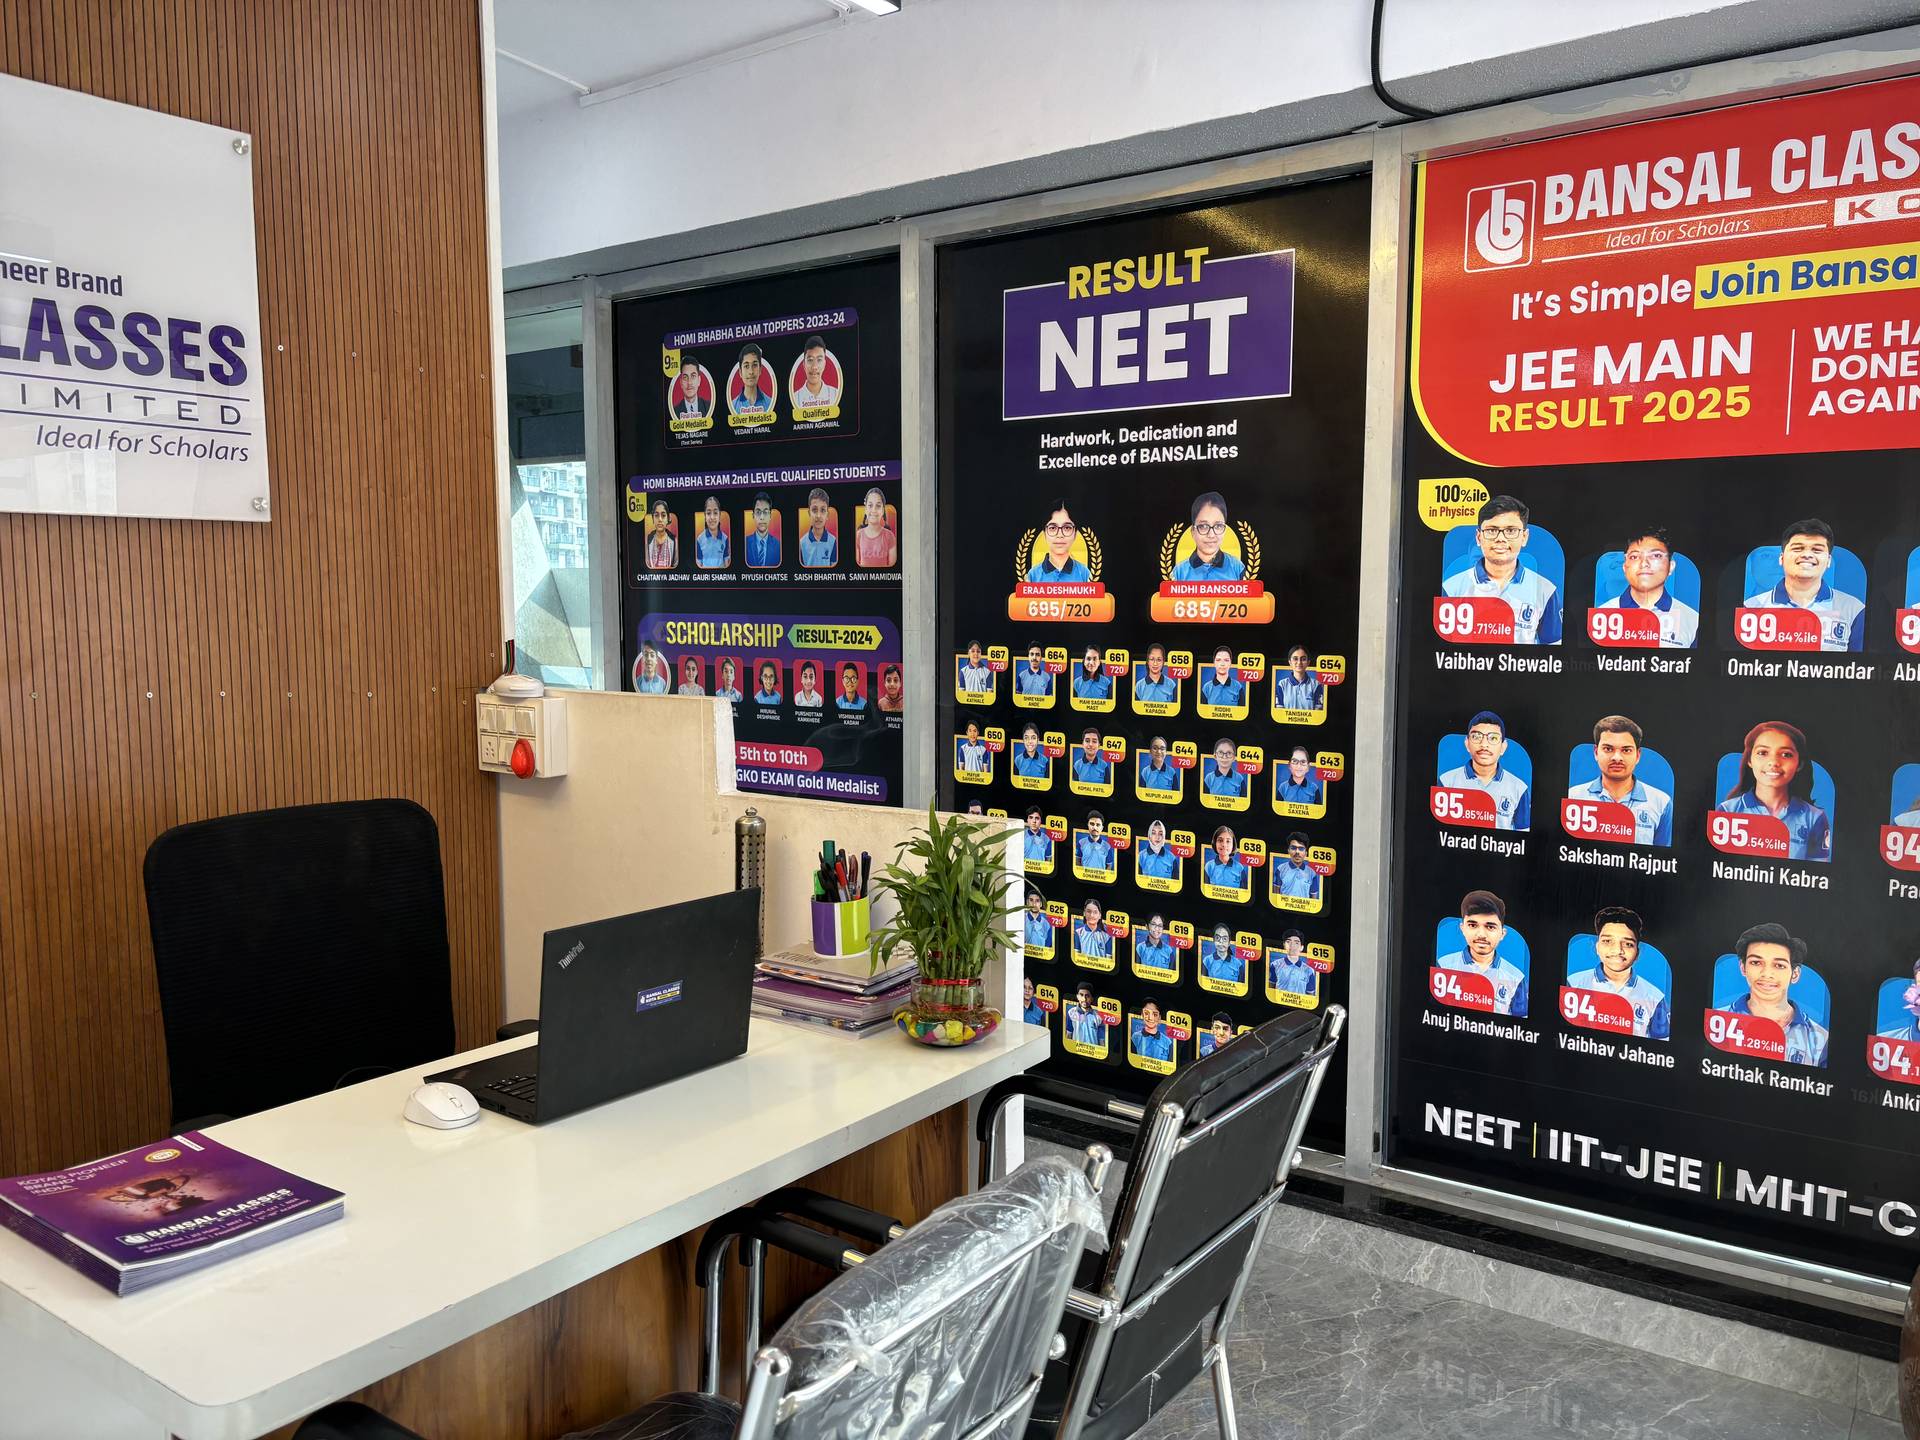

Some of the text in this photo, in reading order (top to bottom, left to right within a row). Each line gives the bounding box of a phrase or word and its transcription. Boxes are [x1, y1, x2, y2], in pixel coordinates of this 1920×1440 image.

[1543, 120, 1920, 225] BANSAL CLAS
[1605, 217, 1750, 250] Ideal for Scholars
[56, 267, 122, 297] Brand
[1068, 247, 1209, 300] RESULT
[1512, 254, 1918, 321] It's Simple Join Bansa
[674, 311, 845, 348] HOMI BHABHA EXAM TOPPERS 2023-24
[1813, 320, 1920, 352] WE H
[1040, 296, 1248, 393] NEET
[1488, 332, 1752, 394] JEE MAIN
[1810, 350, 1919, 384] DONE
[1488, 386, 1751, 433] RESULT 2025
[1808, 385, 1920, 417] AGAI
[732, 413, 773, 426] Silver Medalist
[802, 408, 830, 419] Qualified
[37, 425, 249, 462] Ideal for Scholars
[1040, 419, 1238, 450] Hardwork, Dedication and
[1039, 444, 1238, 470] Excellence of BANSALites
[643, 466, 886, 489] HOMI BHABHA EXAM 2nd LEVEL QUALIFIED STUDENTS
[1435, 485, 1487, 502] 100%ile
[1429, 505, 1475, 519] in Physics
[1022, 586, 1096, 596] ERAA DESHMUKH
[1170, 584, 1249, 595] NIDHI BANSODE
[1027, 600, 1092, 619] 695/720
[1174, 599, 1248, 621] 685/720
[666, 621, 873, 648] SCHOLARSHIP RESULT-2024
[990, 650, 1006, 659] 667
[1047, 651, 1064, 660] 664
[1109, 653, 1125, 662] 661
[1171, 655, 1190, 665] 658
[1241, 657, 1260, 666] 657
[1435, 652, 1563, 674] Vaibhav Shewale
[1320, 659, 1341, 670] 654
[1596, 655, 1691, 674] Vedant Saraf
[1728, 658, 1875, 680] Omkar Nawandar
[987, 731, 1002, 740] 650
[1046, 736, 1062, 745] 648
[1106, 740, 1122, 750] 647
[740, 747, 808, 766] 5th to 10th
[1175, 745, 1193, 755] 644
[1240, 751, 1260, 760] 644
[1319, 756, 1340, 766] 643
[761, 772, 795, 787] EXAM
[797, 775, 823, 790] Gold
[826, 777, 879, 796] Medalist
[1050, 820, 1064, 829] 641
[1110, 826, 1127, 837] 639
[1174, 834, 1191, 844] 638
[1439, 831, 1525, 858] Varad Ghayal
[1313, 850, 1332, 861] 636
[1559, 845, 1678, 875] Saksham Rajput
[1712, 861, 1829, 890] Nandini Kabra
[1174, 925, 1189, 935] 619
[558, 940, 585, 969] ThinkPad
[1312, 947, 1329, 959] 615
[1101, 1001, 1117, 1012] 606
[1170, 1015, 1188, 1027] 604
[1422, 1009, 1540, 1044] Anuj Bhandwalkar
[1558, 1032, 1674, 1069] Vaibhav Jahane
[1701, 1058, 1834, 1097] Sarthak Ramkar
[1424, 1102, 1520, 1150] NEET
[1549, 1129, 1701, 1193] IIT-JEE
[69, 1159, 128, 1176] PIONEER
[23, 1172, 98, 1191] BRAND OF
[30, 1184, 69, 1196] INDIA
[148, 1214, 216, 1238] BANSAL
[216, 1188, 292, 1217] CLASSES
